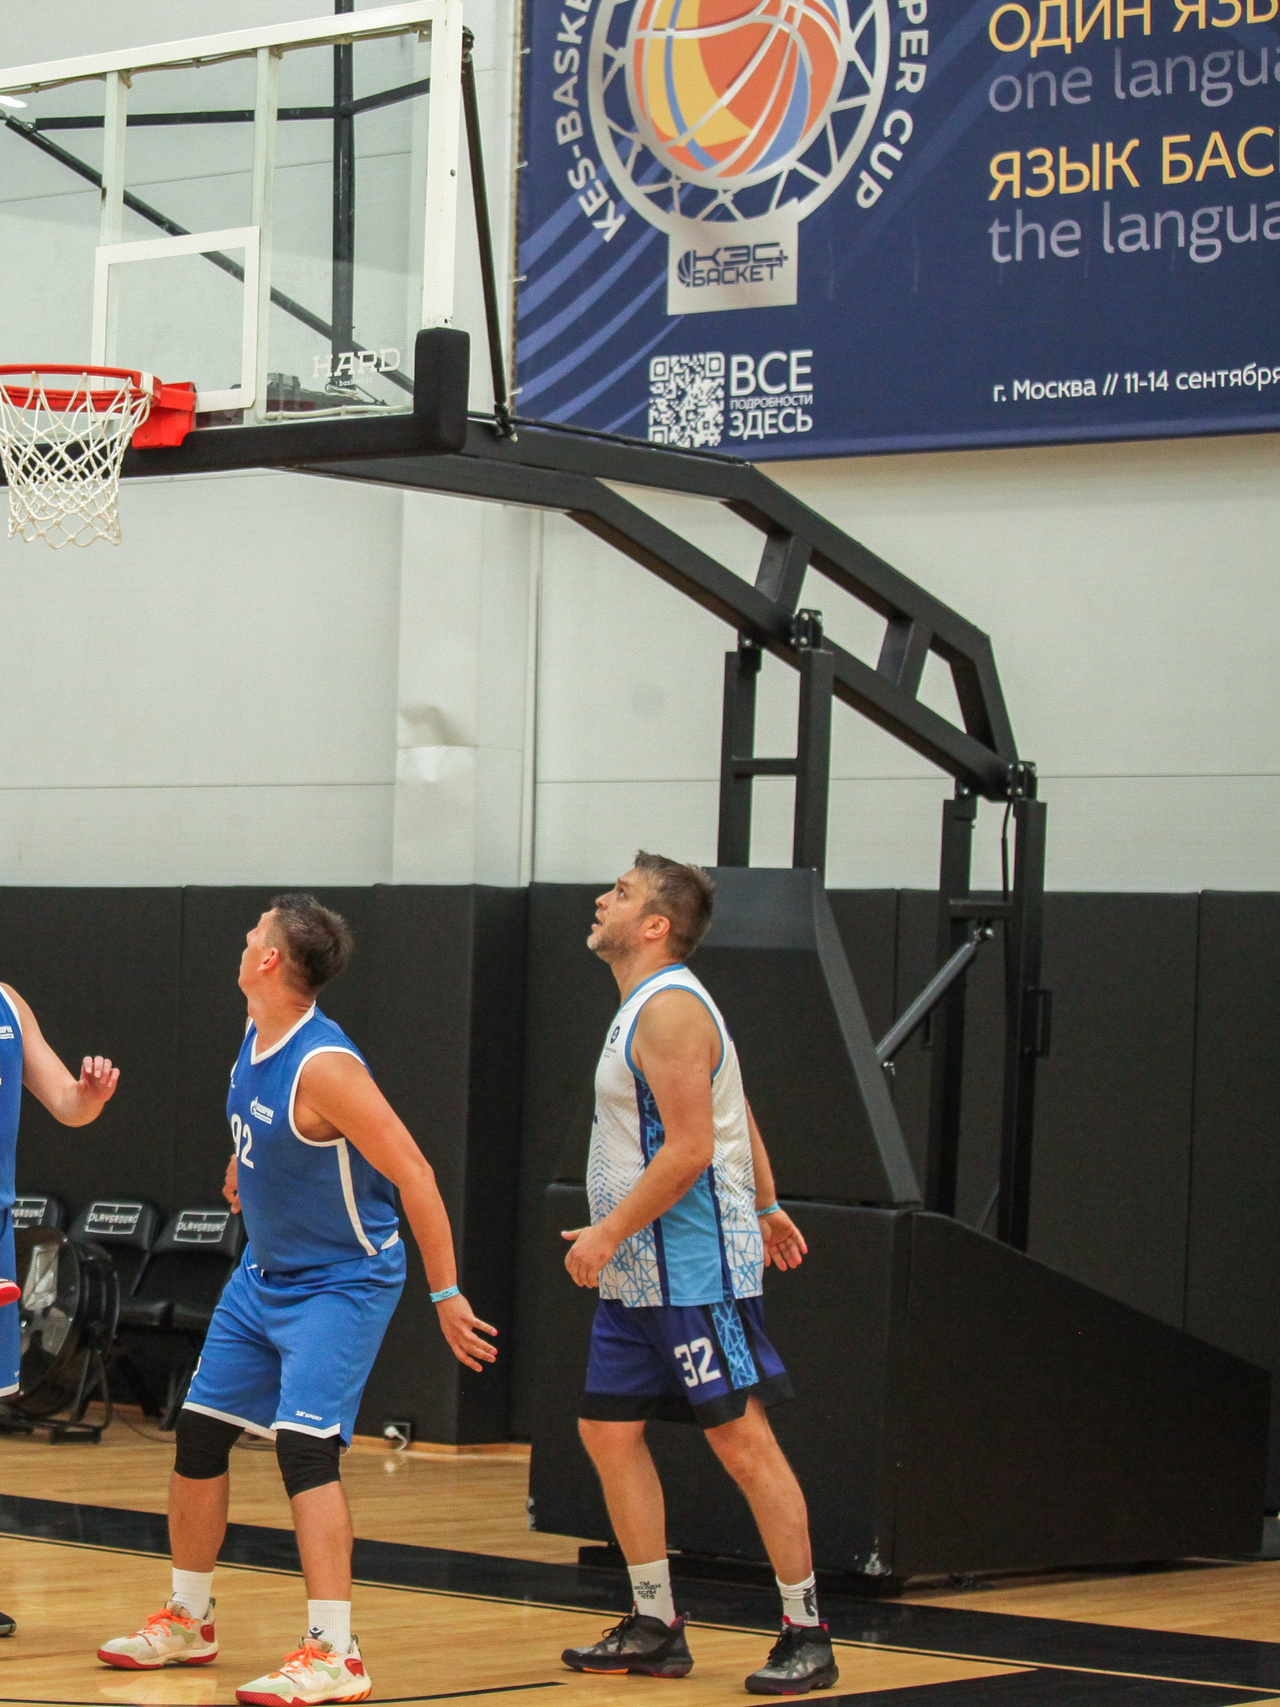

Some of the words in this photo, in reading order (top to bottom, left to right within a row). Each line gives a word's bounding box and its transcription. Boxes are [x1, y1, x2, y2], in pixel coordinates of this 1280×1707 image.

[988, 0, 1151, 58] ОДИН
[1173, 0, 1280, 33] ЯЗ
[989, 66, 1093, 113] one
[1114, 46, 1280, 107] langu
[856, 109, 913, 209] CUP
[988, 138, 1141, 201] ЯЗЫК
[1162, 126, 1280, 185] БАС
[988, 209, 1082, 263] the
[312, 347, 401, 379] HARD
[729, 349, 814, 397] ВСЕ
[993, 384, 1007, 402] г.
[1012, 379, 1097, 401] Москва
[1123, 370, 1170, 394] 11-14
[728, 407, 813, 440] ЗДЕСЬ
[729, 394, 813, 411] ПОДРОБНОСТИ
[673, 1336, 722, 1388] 32
